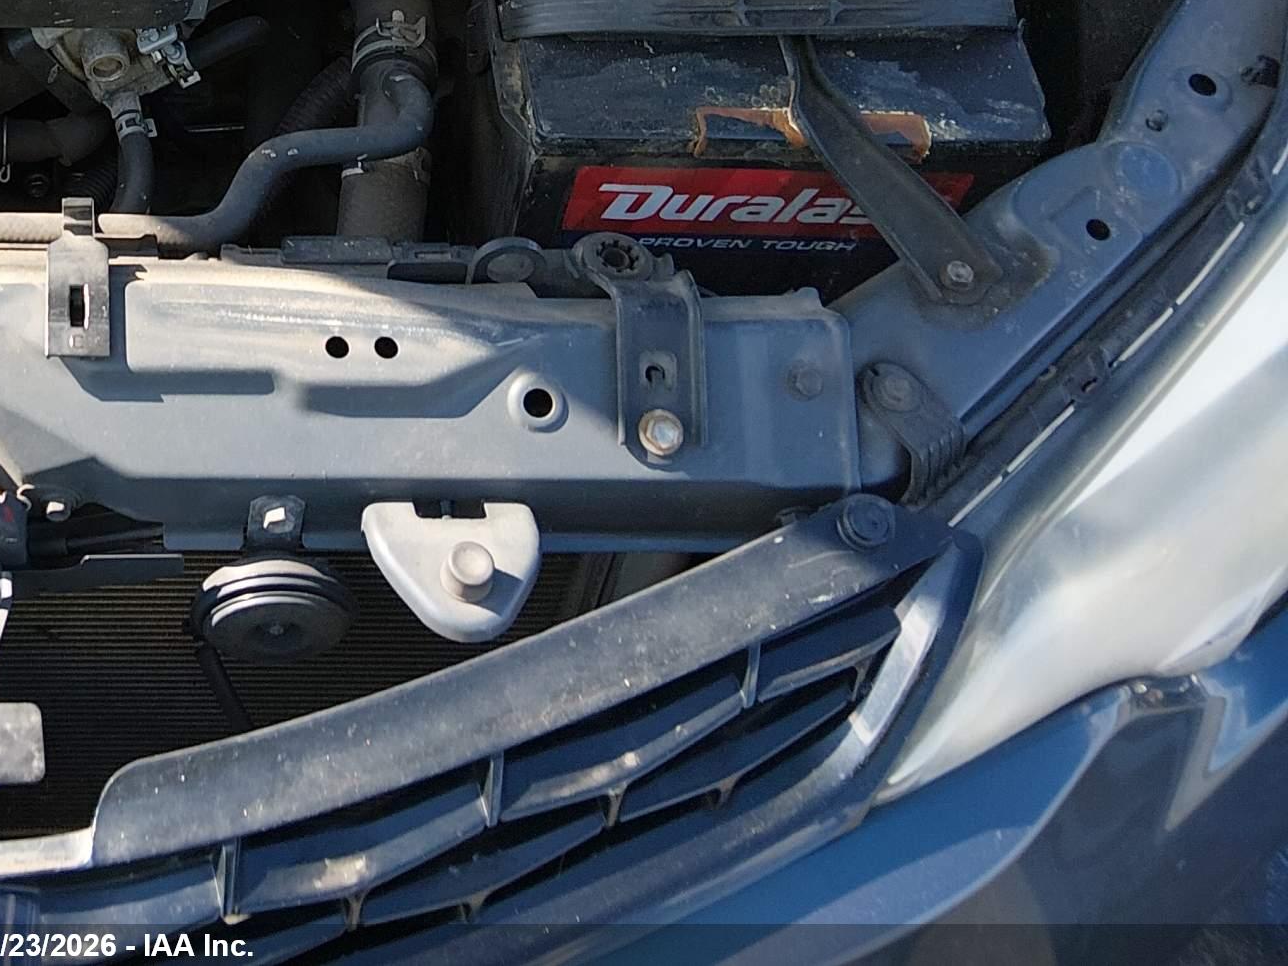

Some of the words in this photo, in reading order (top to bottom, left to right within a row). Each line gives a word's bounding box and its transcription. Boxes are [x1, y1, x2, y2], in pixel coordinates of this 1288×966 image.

[598, 183, 874, 225] Duralas
[639, 237, 753, 250] PROVEN
[761, 239, 858, 252] TOUGH
